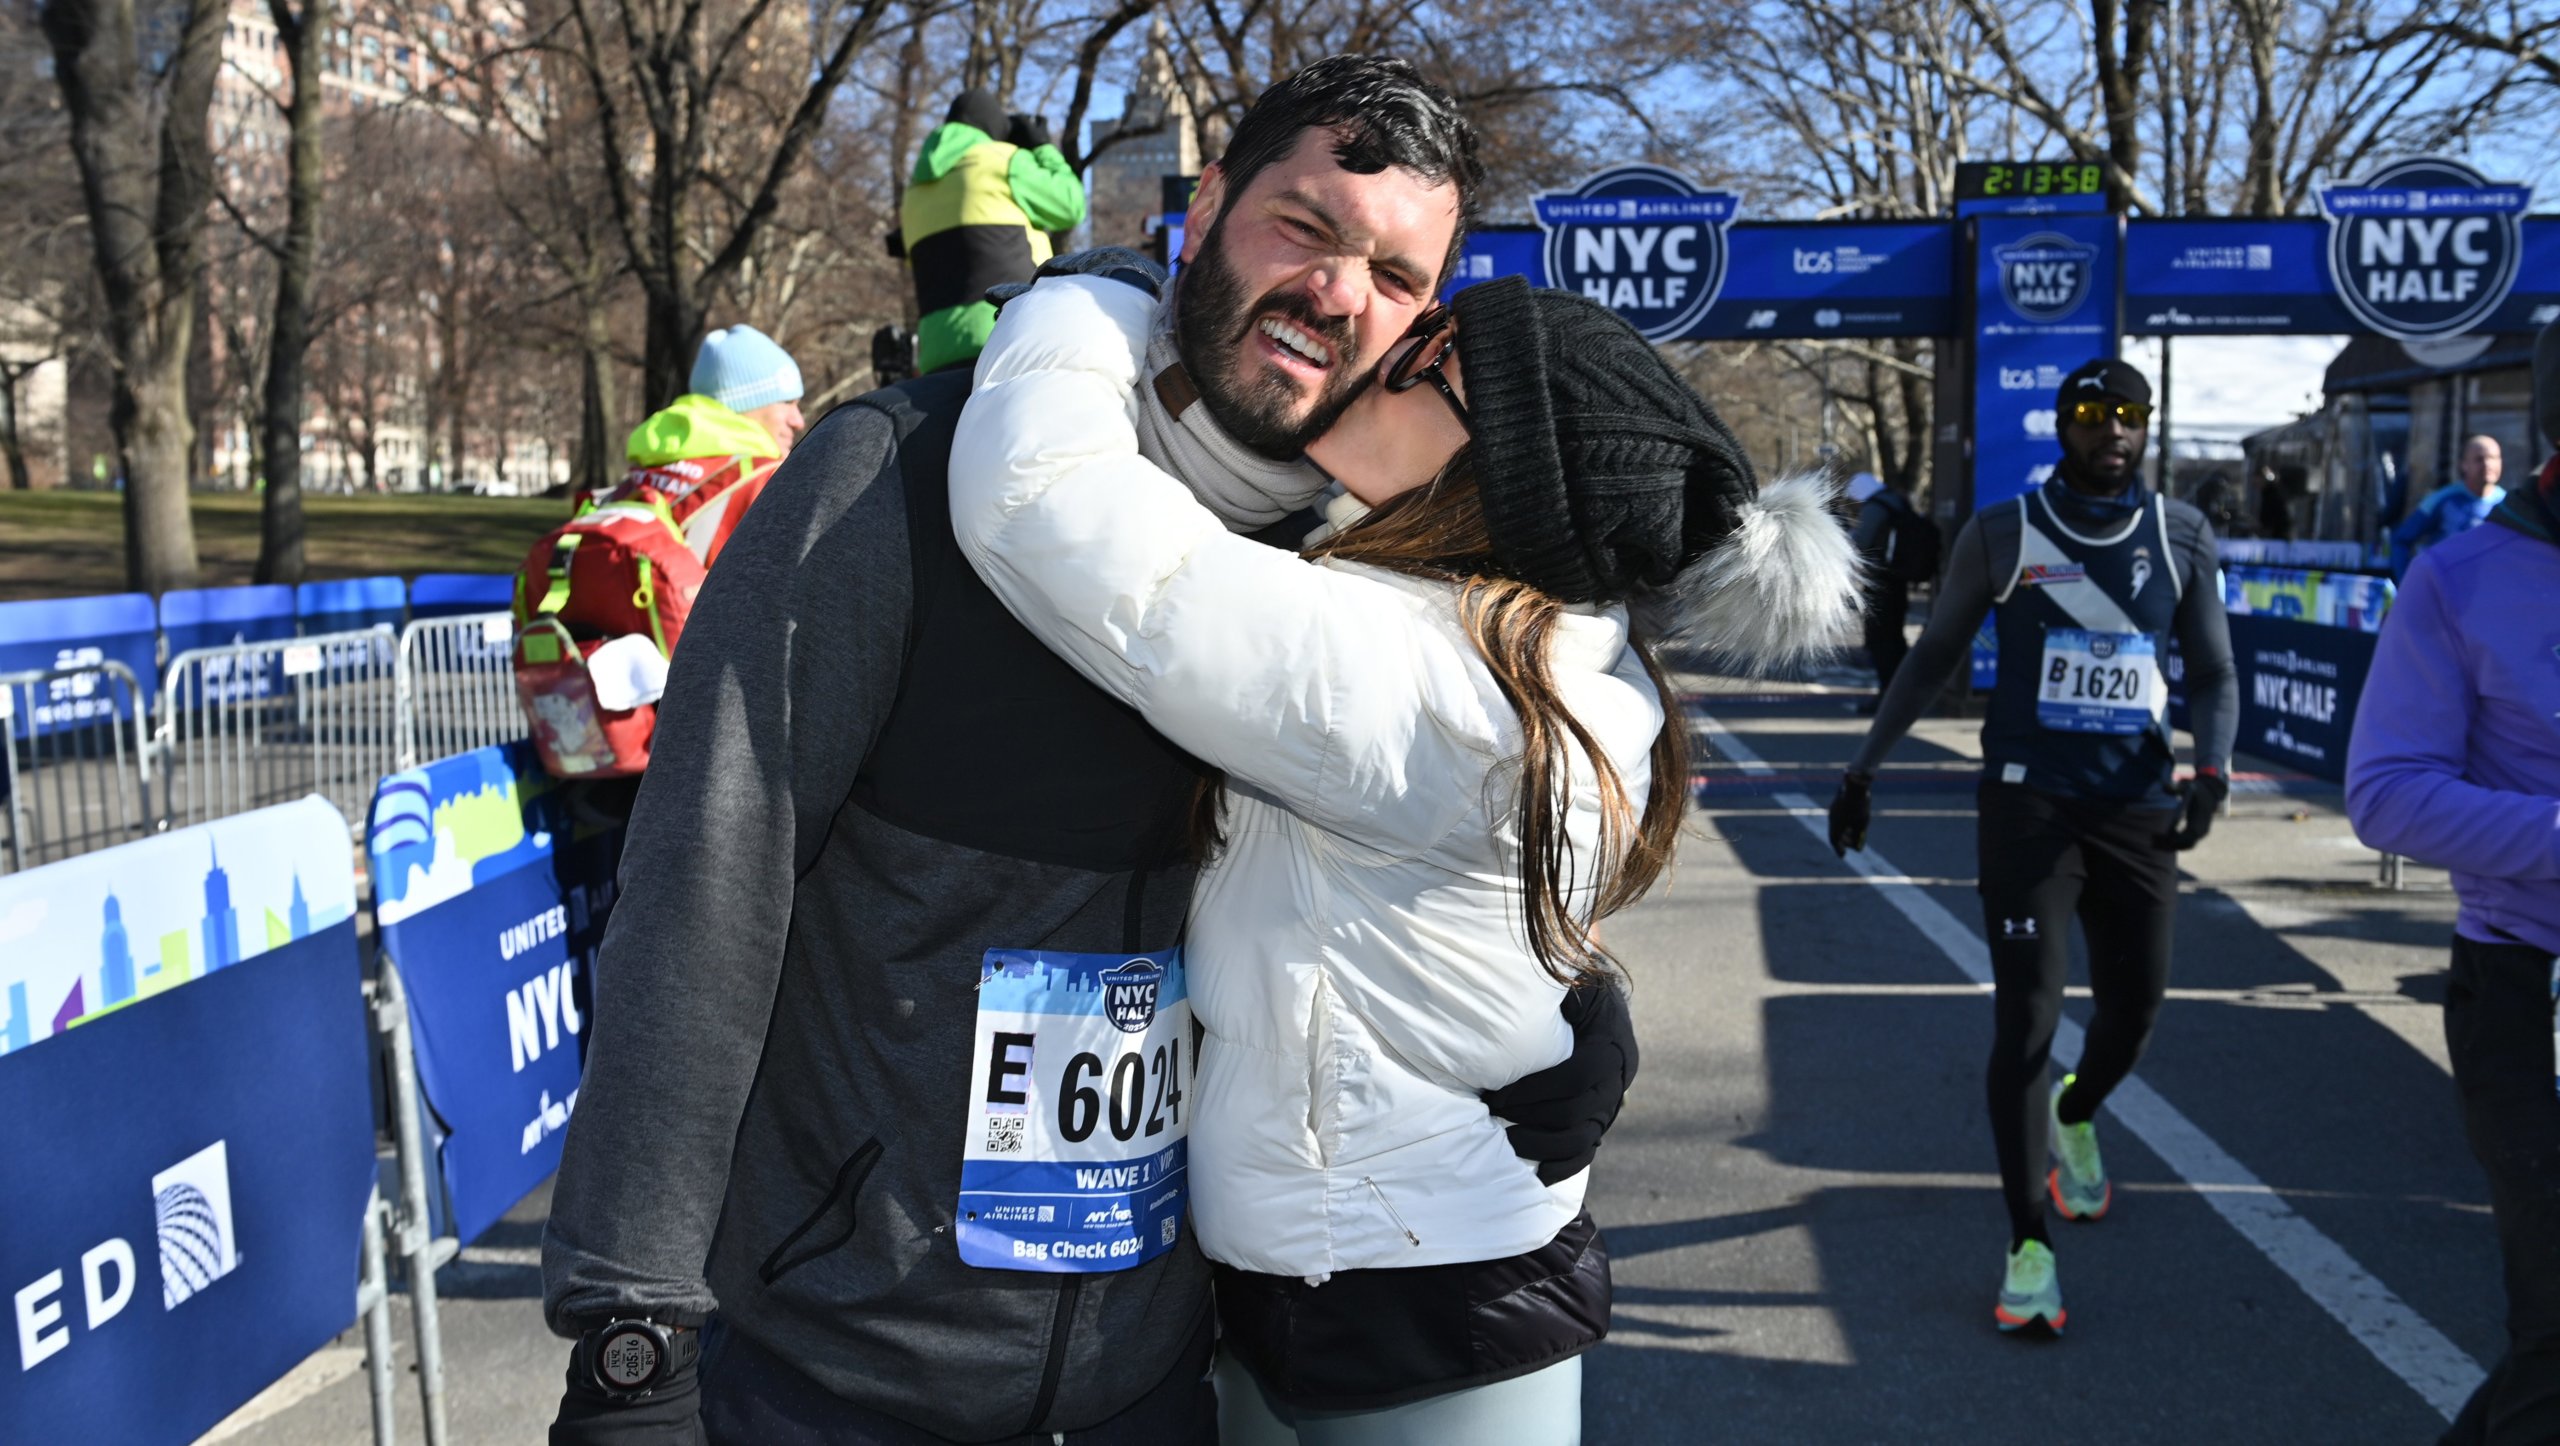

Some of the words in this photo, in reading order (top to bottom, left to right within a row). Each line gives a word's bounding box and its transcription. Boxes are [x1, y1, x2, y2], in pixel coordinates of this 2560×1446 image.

[1547, 204, 1616, 217] UNITED
[1639, 203, 1724, 215] AIRLINES
[2332, 194, 2406, 208] UNITED
[2428, 193, 2519, 207] AIRLINES
[1574, 225, 1697, 273] NYC
[2360, 217, 2490, 266] NYC
[1793, 247, 1833, 273] tcs
[2014, 262, 2076, 287] NYC
[2368, 269, 2479, 301] HALF
[1583, 277, 1687, 308] HALF
[2017, 287, 2071, 304] HALF
[2001, 366, 2036, 390] tcs
[2047, 657, 2068, 684] B
[2072, 666, 2139, 700] 1620
[2254, 672, 2289, 713] NYC
[2290, 680, 2337, 724] HALF
[1115, 984, 1155, 1005] NYC
[506, 960, 583, 1073] NYC
[1116, 1005, 1152, 1020] HALF
[987, 1032, 1034, 1105] E
[1058, 1038, 1182, 1143] 6024
[1075, 1165, 1139, 1189] WAVE
[1143, 1163, 1150, 1183] 1
[1160, 1149, 1174, 1173] VIP
[984, 1212, 1035, 1221] AIRLINES
[995, 1205, 1036, 1214] UNITED
[1013, 1240, 1048, 1260] Bag
[1052, 1241, 1106, 1259] Check
[1110, 1236, 1144, 1257] 6024
[626, 1339, 639, 1377] 2:05:16
